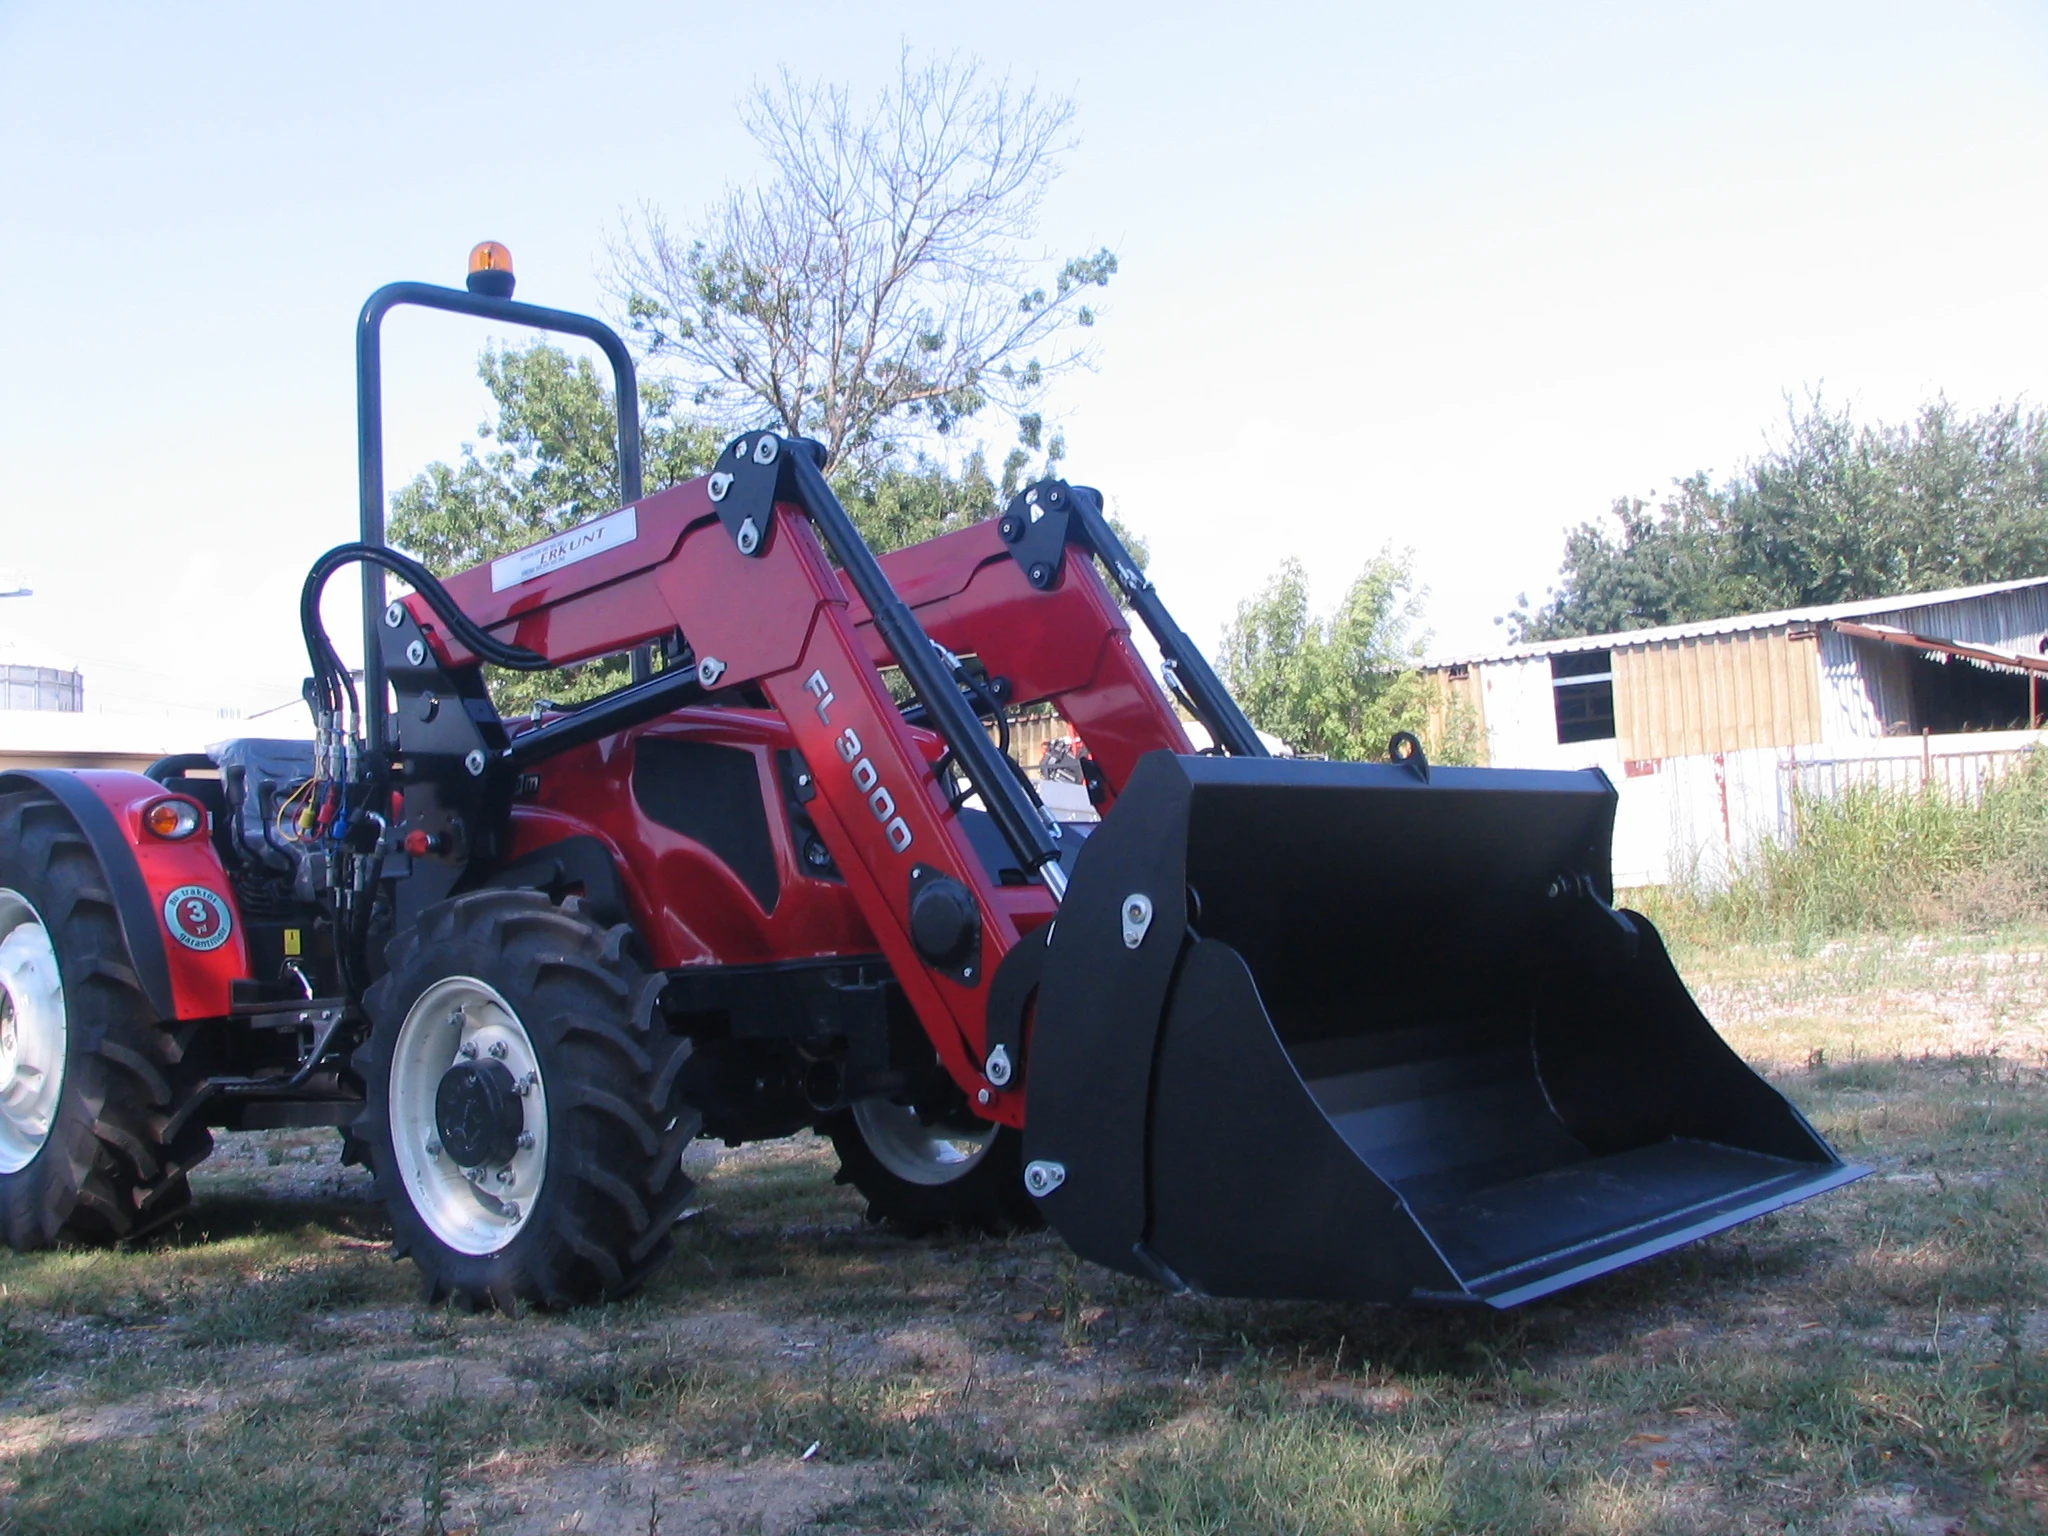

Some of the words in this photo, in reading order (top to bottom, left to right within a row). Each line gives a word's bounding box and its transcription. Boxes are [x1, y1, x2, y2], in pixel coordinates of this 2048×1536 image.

[540, 526, 607, 565] ERKUNT
[803, 669, 835, 726] FL
[836, 727, 913, 854] 3000
[186, 900, 207, 922] 3
